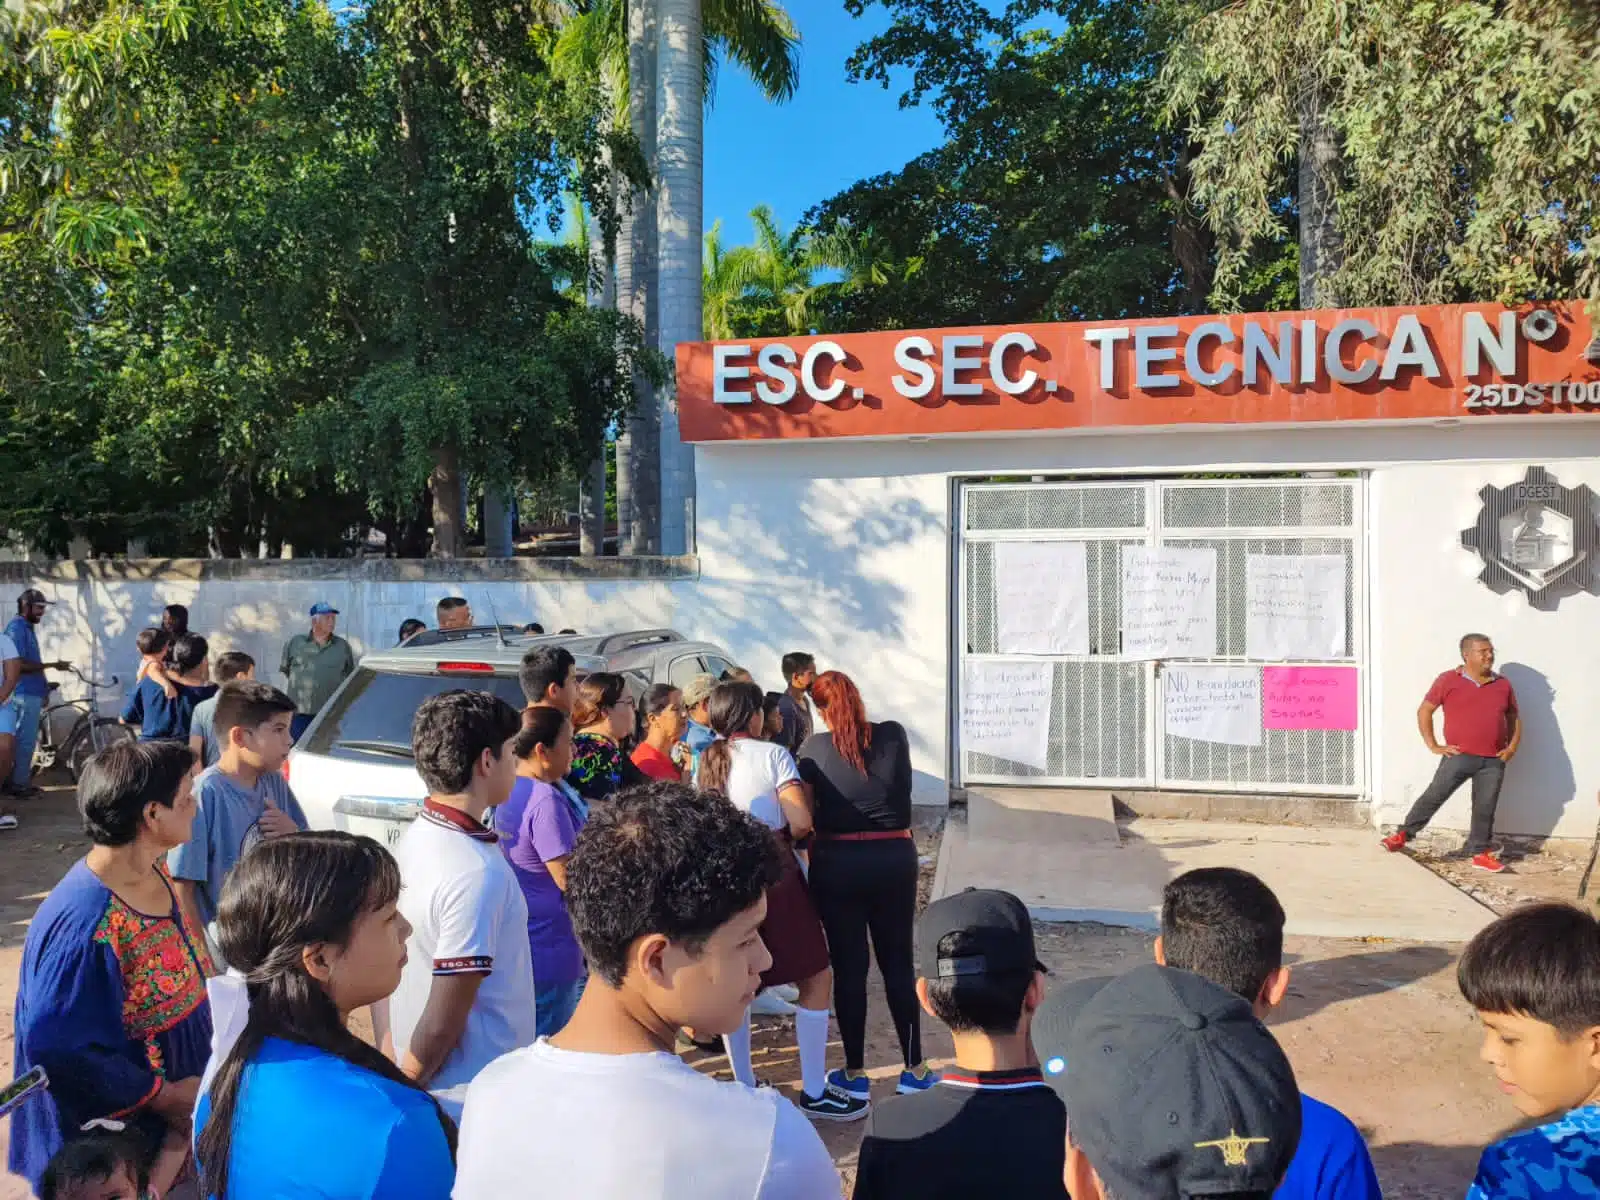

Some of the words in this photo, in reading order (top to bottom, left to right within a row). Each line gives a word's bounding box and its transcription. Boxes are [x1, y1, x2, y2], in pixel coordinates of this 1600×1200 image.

[713, 341, 864, 404] ESC.
[891, 332, 1057, 399] SEC.
[1084, 314, 1440, 390] TECNICA
[1519, 485, 1557, 499] DGEST
[1168, 671, 1189, 692] NO
